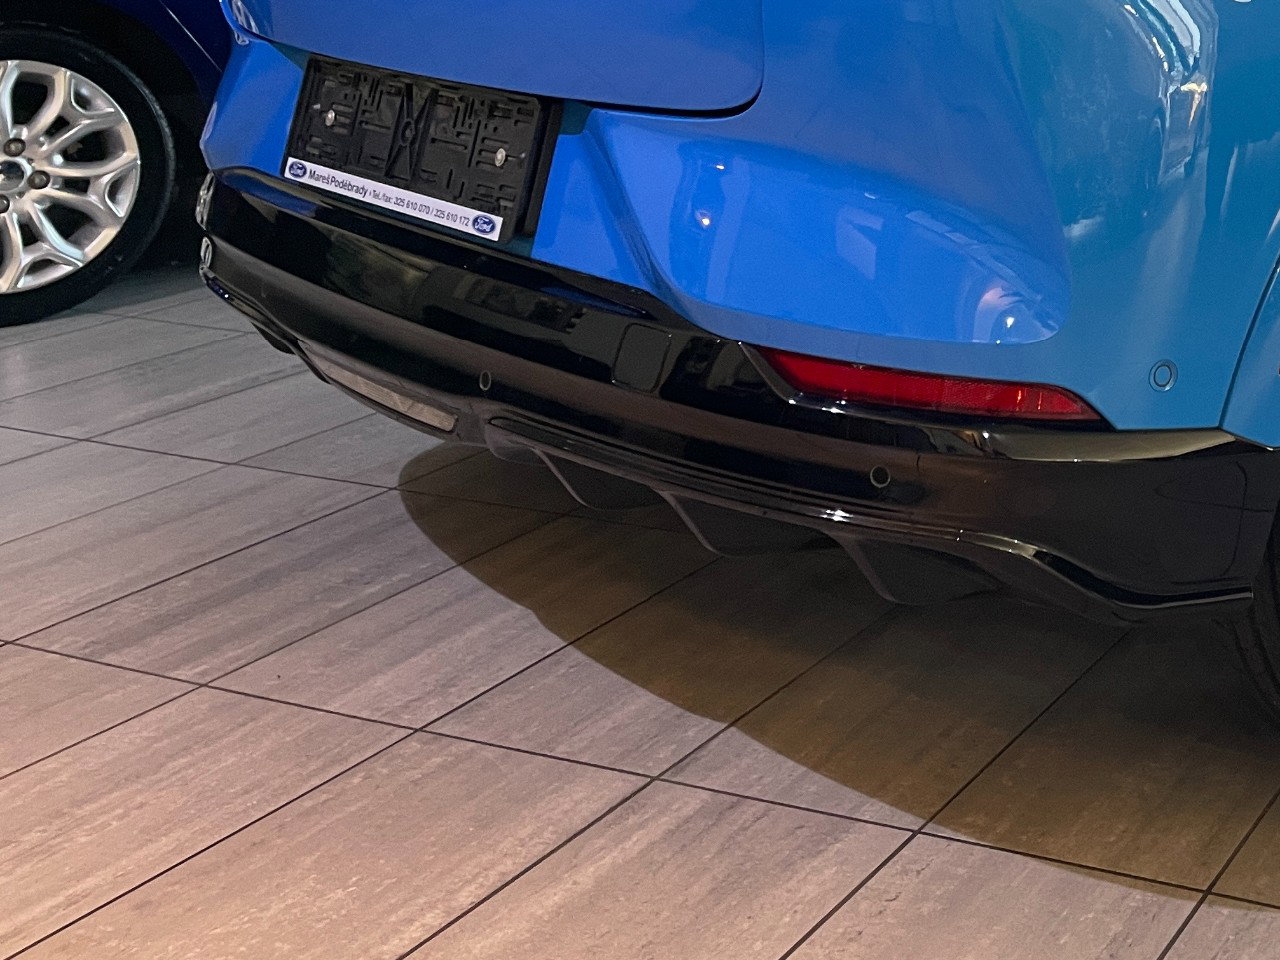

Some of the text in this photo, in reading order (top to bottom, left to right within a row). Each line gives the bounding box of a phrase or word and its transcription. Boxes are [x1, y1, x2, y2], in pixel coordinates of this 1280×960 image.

[394, 196, 405, 208] 325
[406, 200, 418, 211] 610
[418, 203, 431, 215] 070
[434, 208, 446, 219] 325
[446, 212, 458, 223] 610
[459, 215, 470, 227] 172
